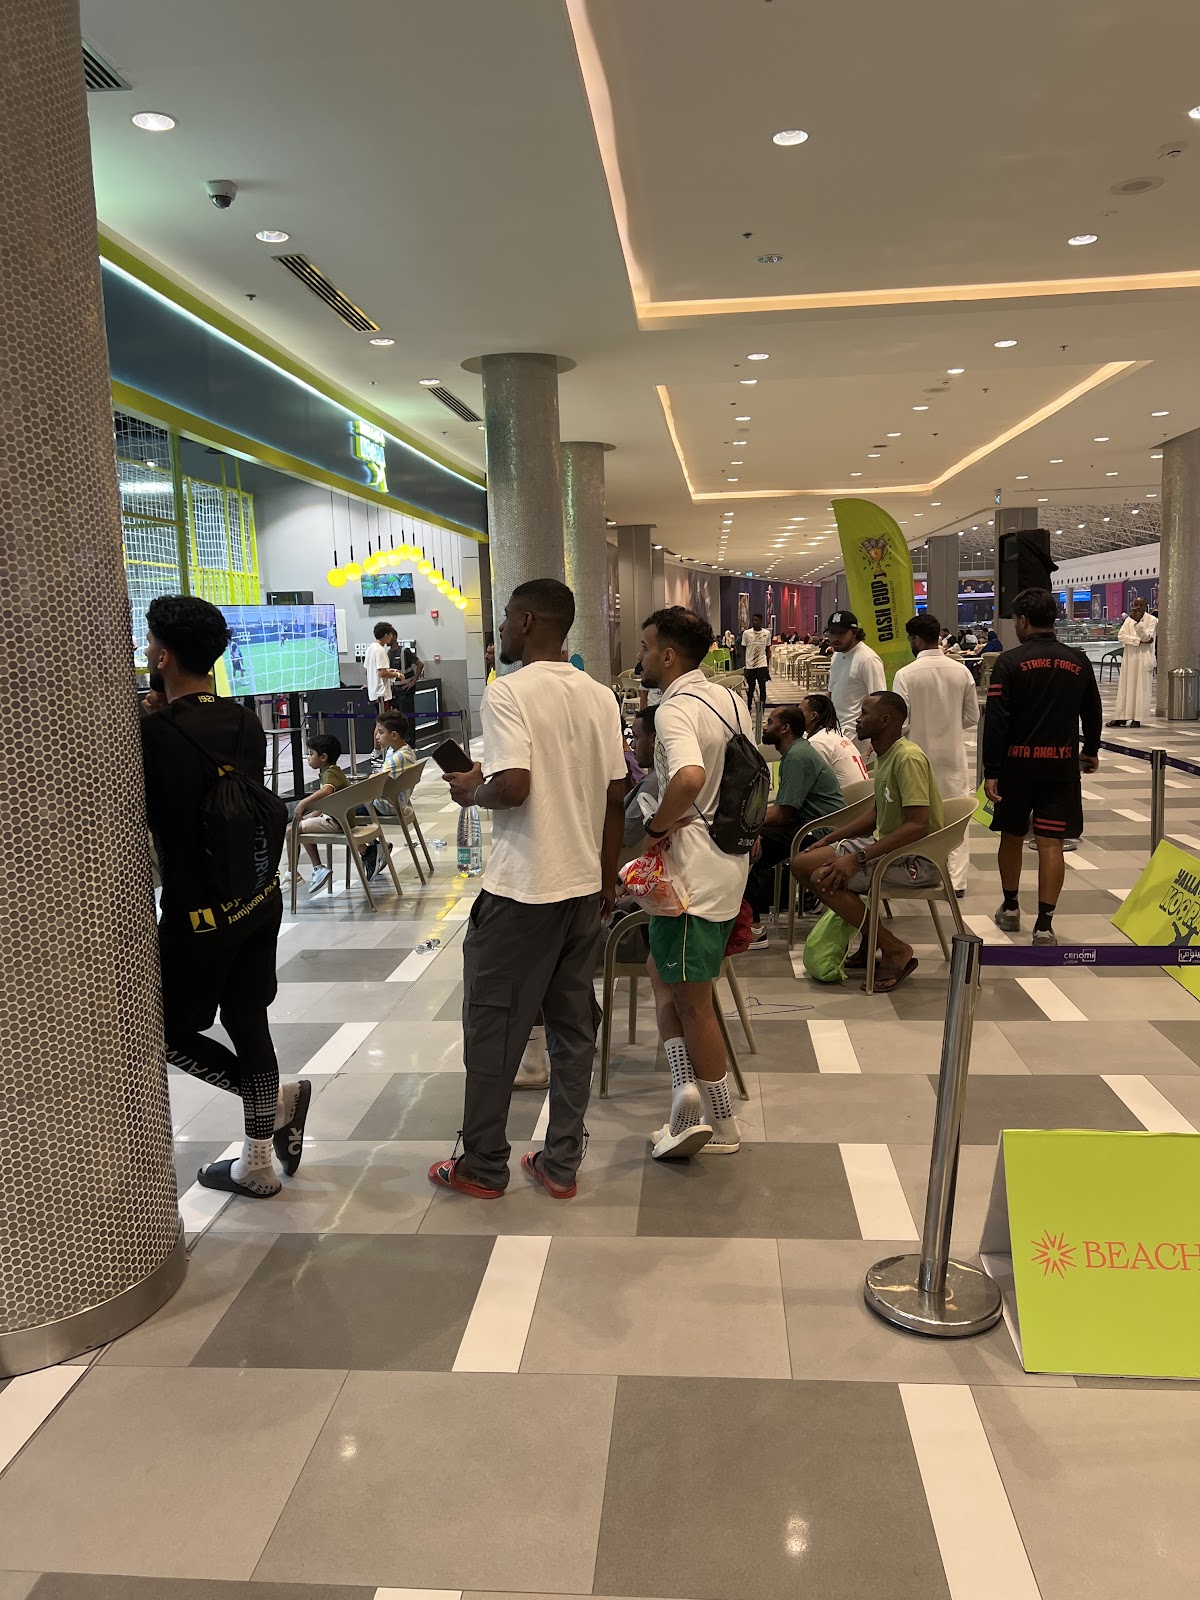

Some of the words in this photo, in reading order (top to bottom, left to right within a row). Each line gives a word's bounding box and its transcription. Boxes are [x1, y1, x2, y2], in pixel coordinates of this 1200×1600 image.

[870, 580, 891, 606] CUP
[875, 608, 894, 642] CASH
[1020, 658, 1051, 672] STRIKE
[1053, 659, 1082, 675] FORCE
[1008, 745, 1031, 758] DATA
[227, 893, 265, 924] Jamjoom
[205, 1070, 240, 1095] eep
[1082, 1241, 1200, 1271] BEACH
